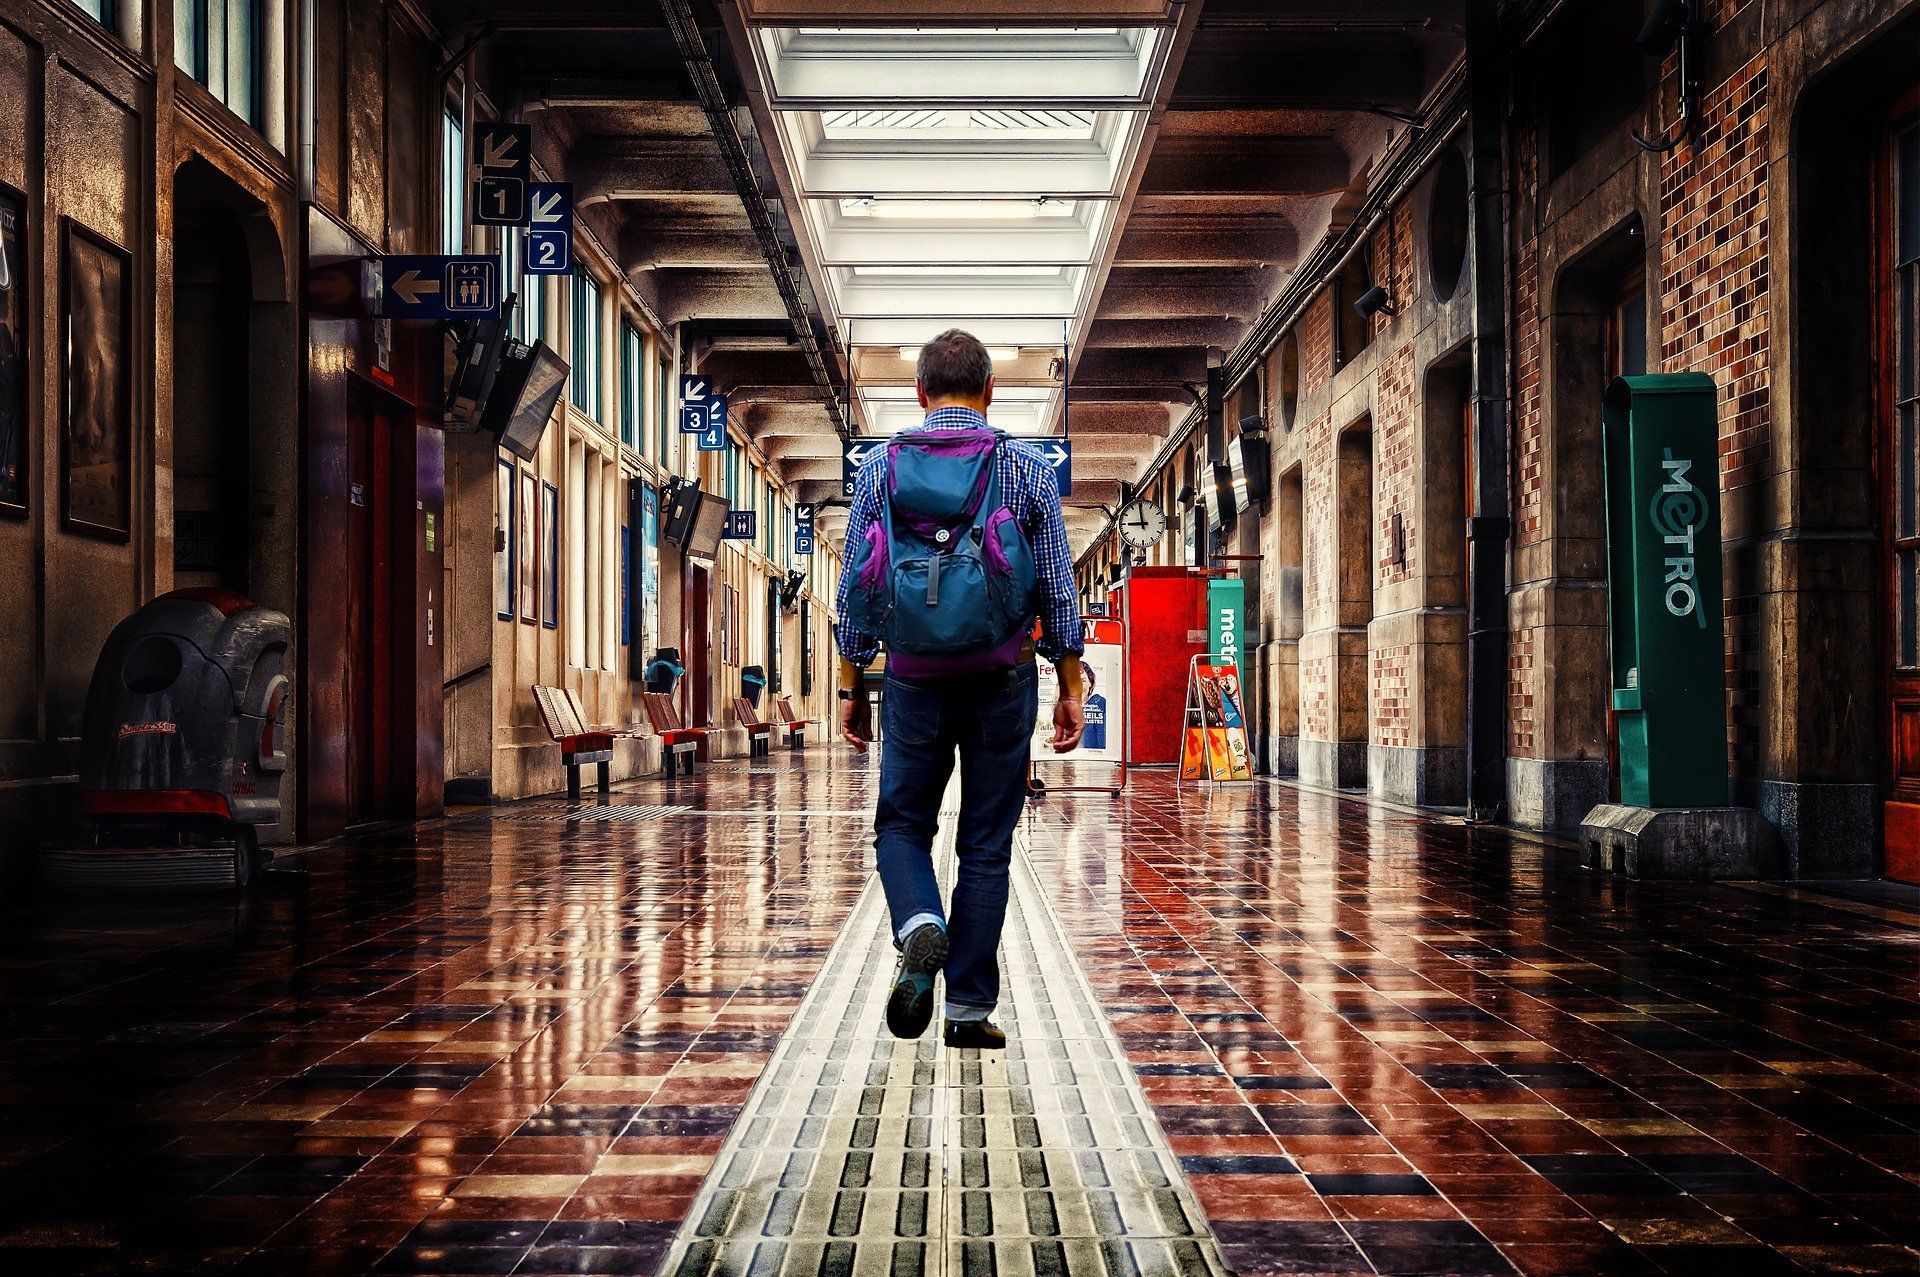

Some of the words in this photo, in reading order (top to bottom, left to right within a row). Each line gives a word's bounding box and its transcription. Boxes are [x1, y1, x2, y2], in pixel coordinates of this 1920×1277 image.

[493, 189, 506, 215] 1
[539, 241, 556, 265] 2
[690, 412, 701, 428] 3
[706, 430, 718, 445] 4
[845, 482, 855, 494] 3
[800, 539, 809, 551] P
[1220, 608, 1239, 666] metr
